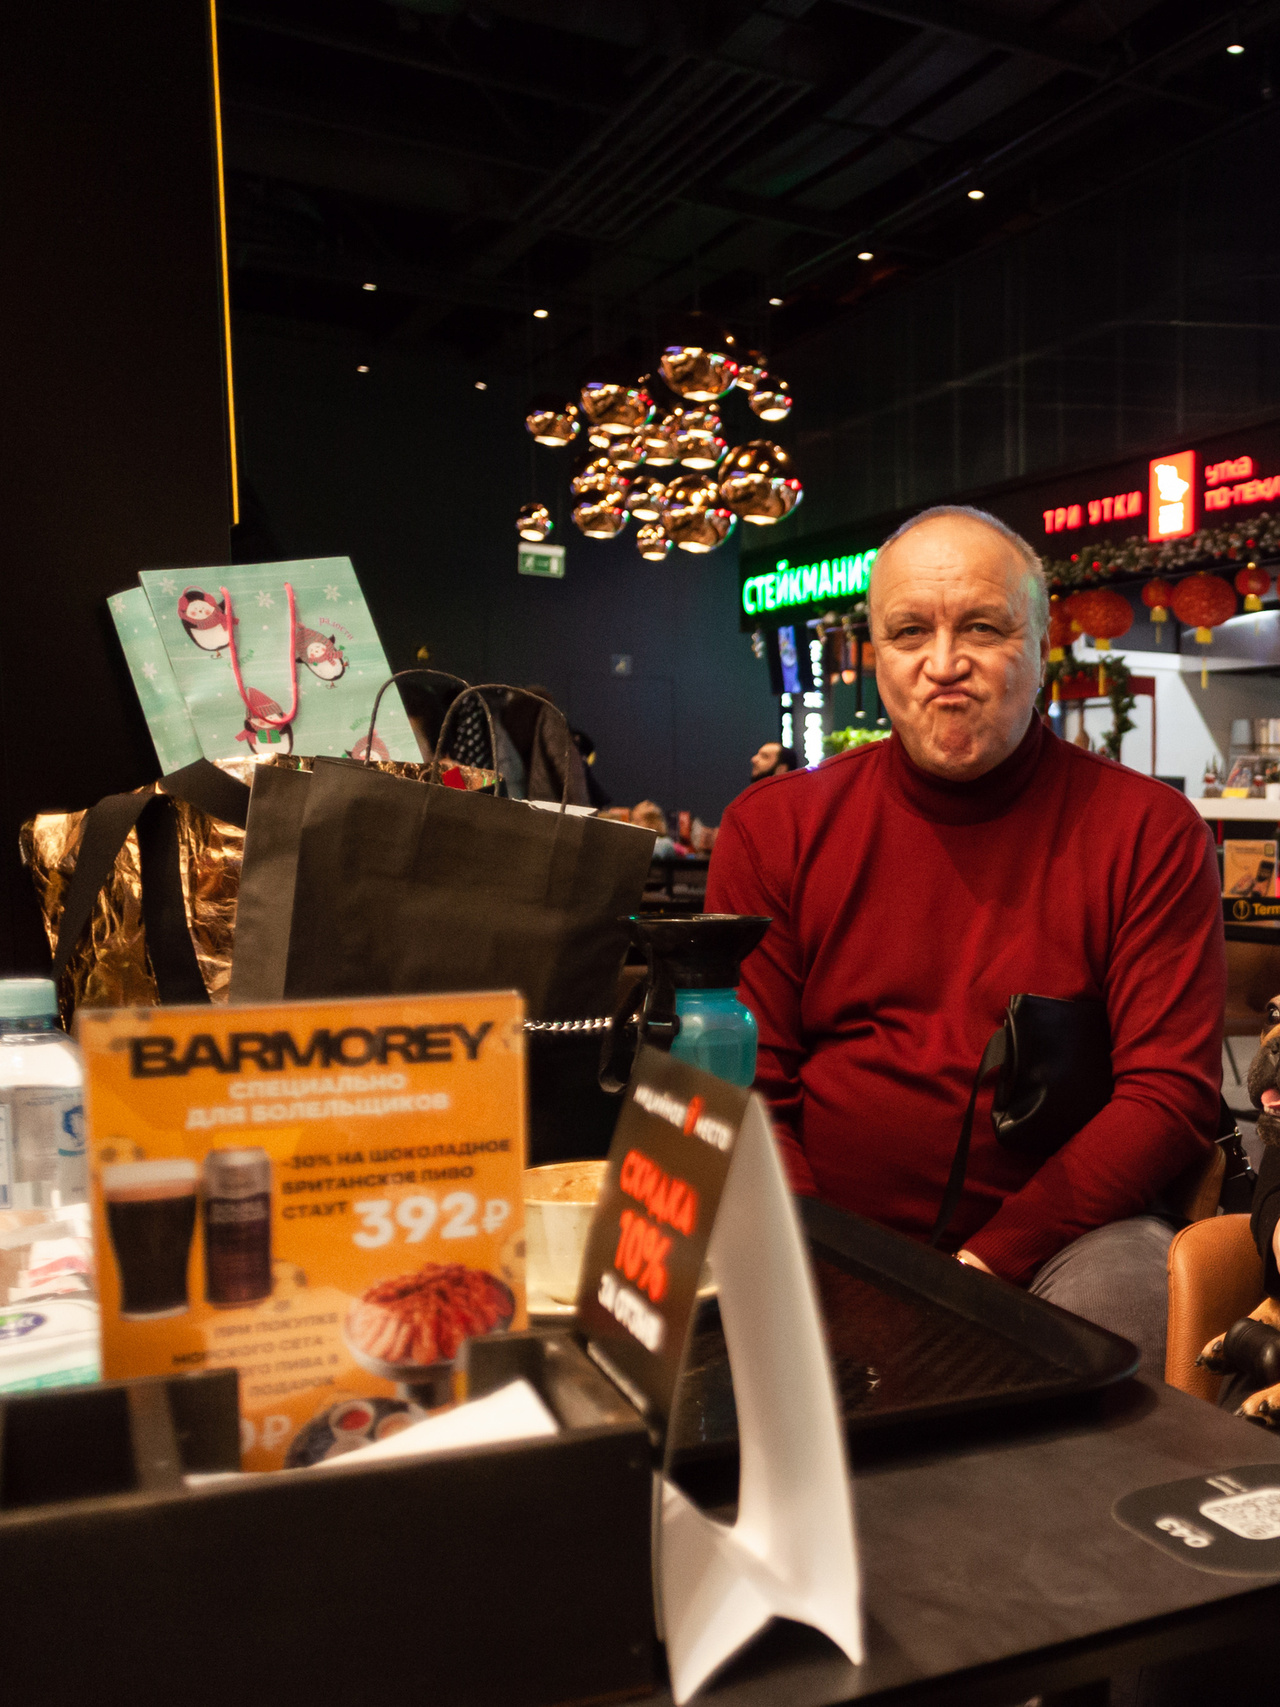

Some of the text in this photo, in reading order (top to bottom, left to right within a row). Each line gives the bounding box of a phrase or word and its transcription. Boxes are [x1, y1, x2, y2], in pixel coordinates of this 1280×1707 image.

[1043, 490, 1143, 534] ТРИ УТКИ
[130, 1021, 495, 1079] BARMOREY
[228, 1073, 407, 1099] СПЕЦИАЛЬНО
[185, 1092, 451, 1130] ДЛЯ БОЛЕЛЬЩИКОВ
[336, 1151, 365, 1165] НА
[369, 1138, 511, 1163] ШОКОЛАДНОЕ
[282, 1166, 475, 1194] БРИТАНСКОЕ ПИВО
[620, 1149, 697, 1235] СКИДКА
[283, 1201, 347, 1220] СТАУТ
[615, 1209, 669, 1301] 10%
